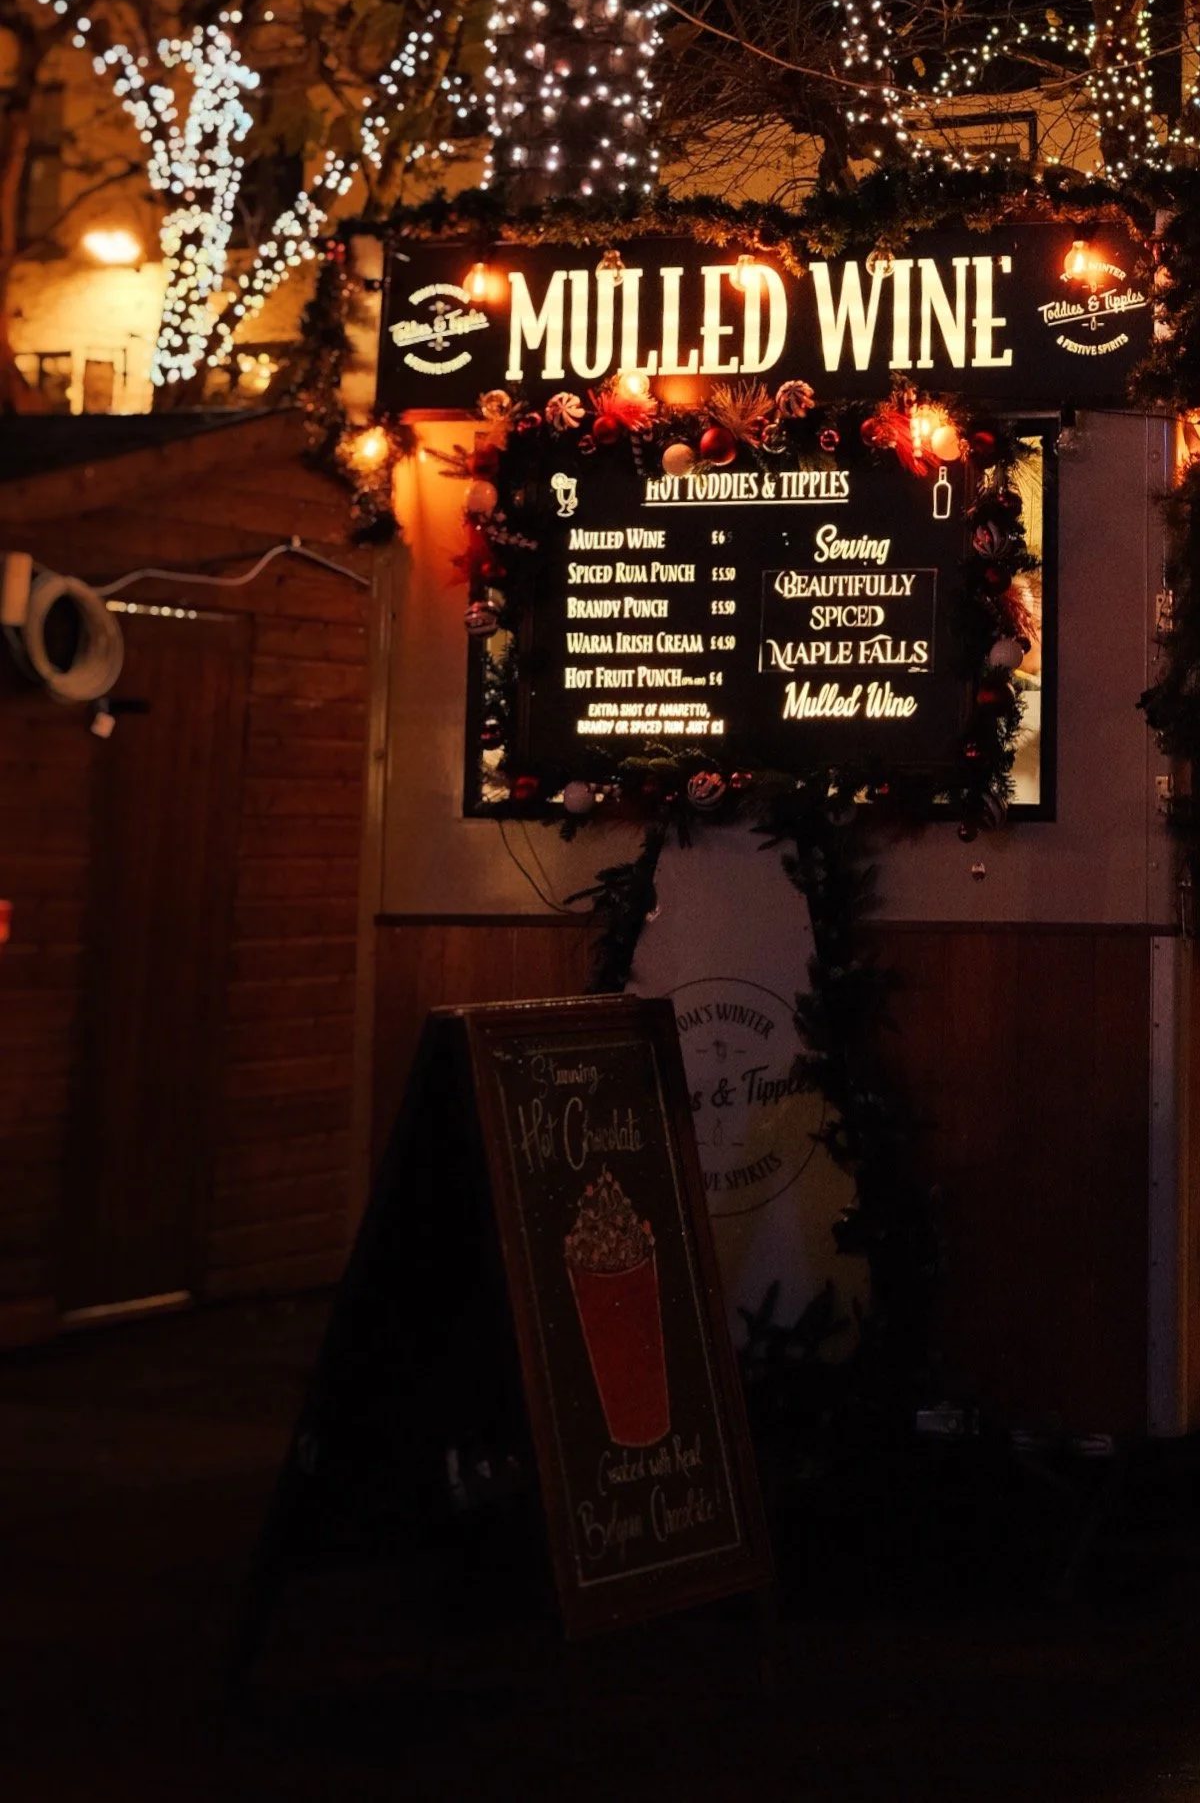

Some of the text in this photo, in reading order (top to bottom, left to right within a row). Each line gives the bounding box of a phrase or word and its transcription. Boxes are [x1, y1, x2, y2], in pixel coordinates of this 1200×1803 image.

[505, 256, 1013, 381] MULLED WINE
[1037, 288, 1145, 324] Toddies & Tipples
[1097, 333, 1129, 355] SPIRITS
[645, 471, 850, 501] HOT TODDIES & TIPPLES
[568, 528, 624, 550] MULLED
[625, 527, 666, 549] WINE
[813, 523, 891, 565] Serving
[567, 562, 613, 584] SPICED
[650, 561, 696, 583] PUNCH
[774, 570, 917, 600] BEAUTIFULLY
[566, 596, 622, 619] BRANDY
[623, 596, 669, 618] PUNCH
[809, 605, 885, 631] SPICED
[566, 632, 613, 654] WARM
[615, 632, 654, 653] IRISH
[656, 631, 704, 653] CREAM
[766, 633, 929, 672] MAPLE FALLS
[564, 667, 594, 689] HOT
[595, 666, 636, 688] FRUIT
[637, 666, 683, 687] PUNCH
[709, 671, 723, 686] £4
[588, 703, 618, 717] EXTRA
[620, 703, 644, 717] SHOT
[645, 703, 658, 717] OF
[782, 680, 918, 720] Mulled Wine
[677, 1002, 775, 1040] OM'S WINTER
[711, 1078, 736, 1108] &
[517, 1097, 560, 1174] Hot
[724, 1150, 782, 1191] SPIRITS
